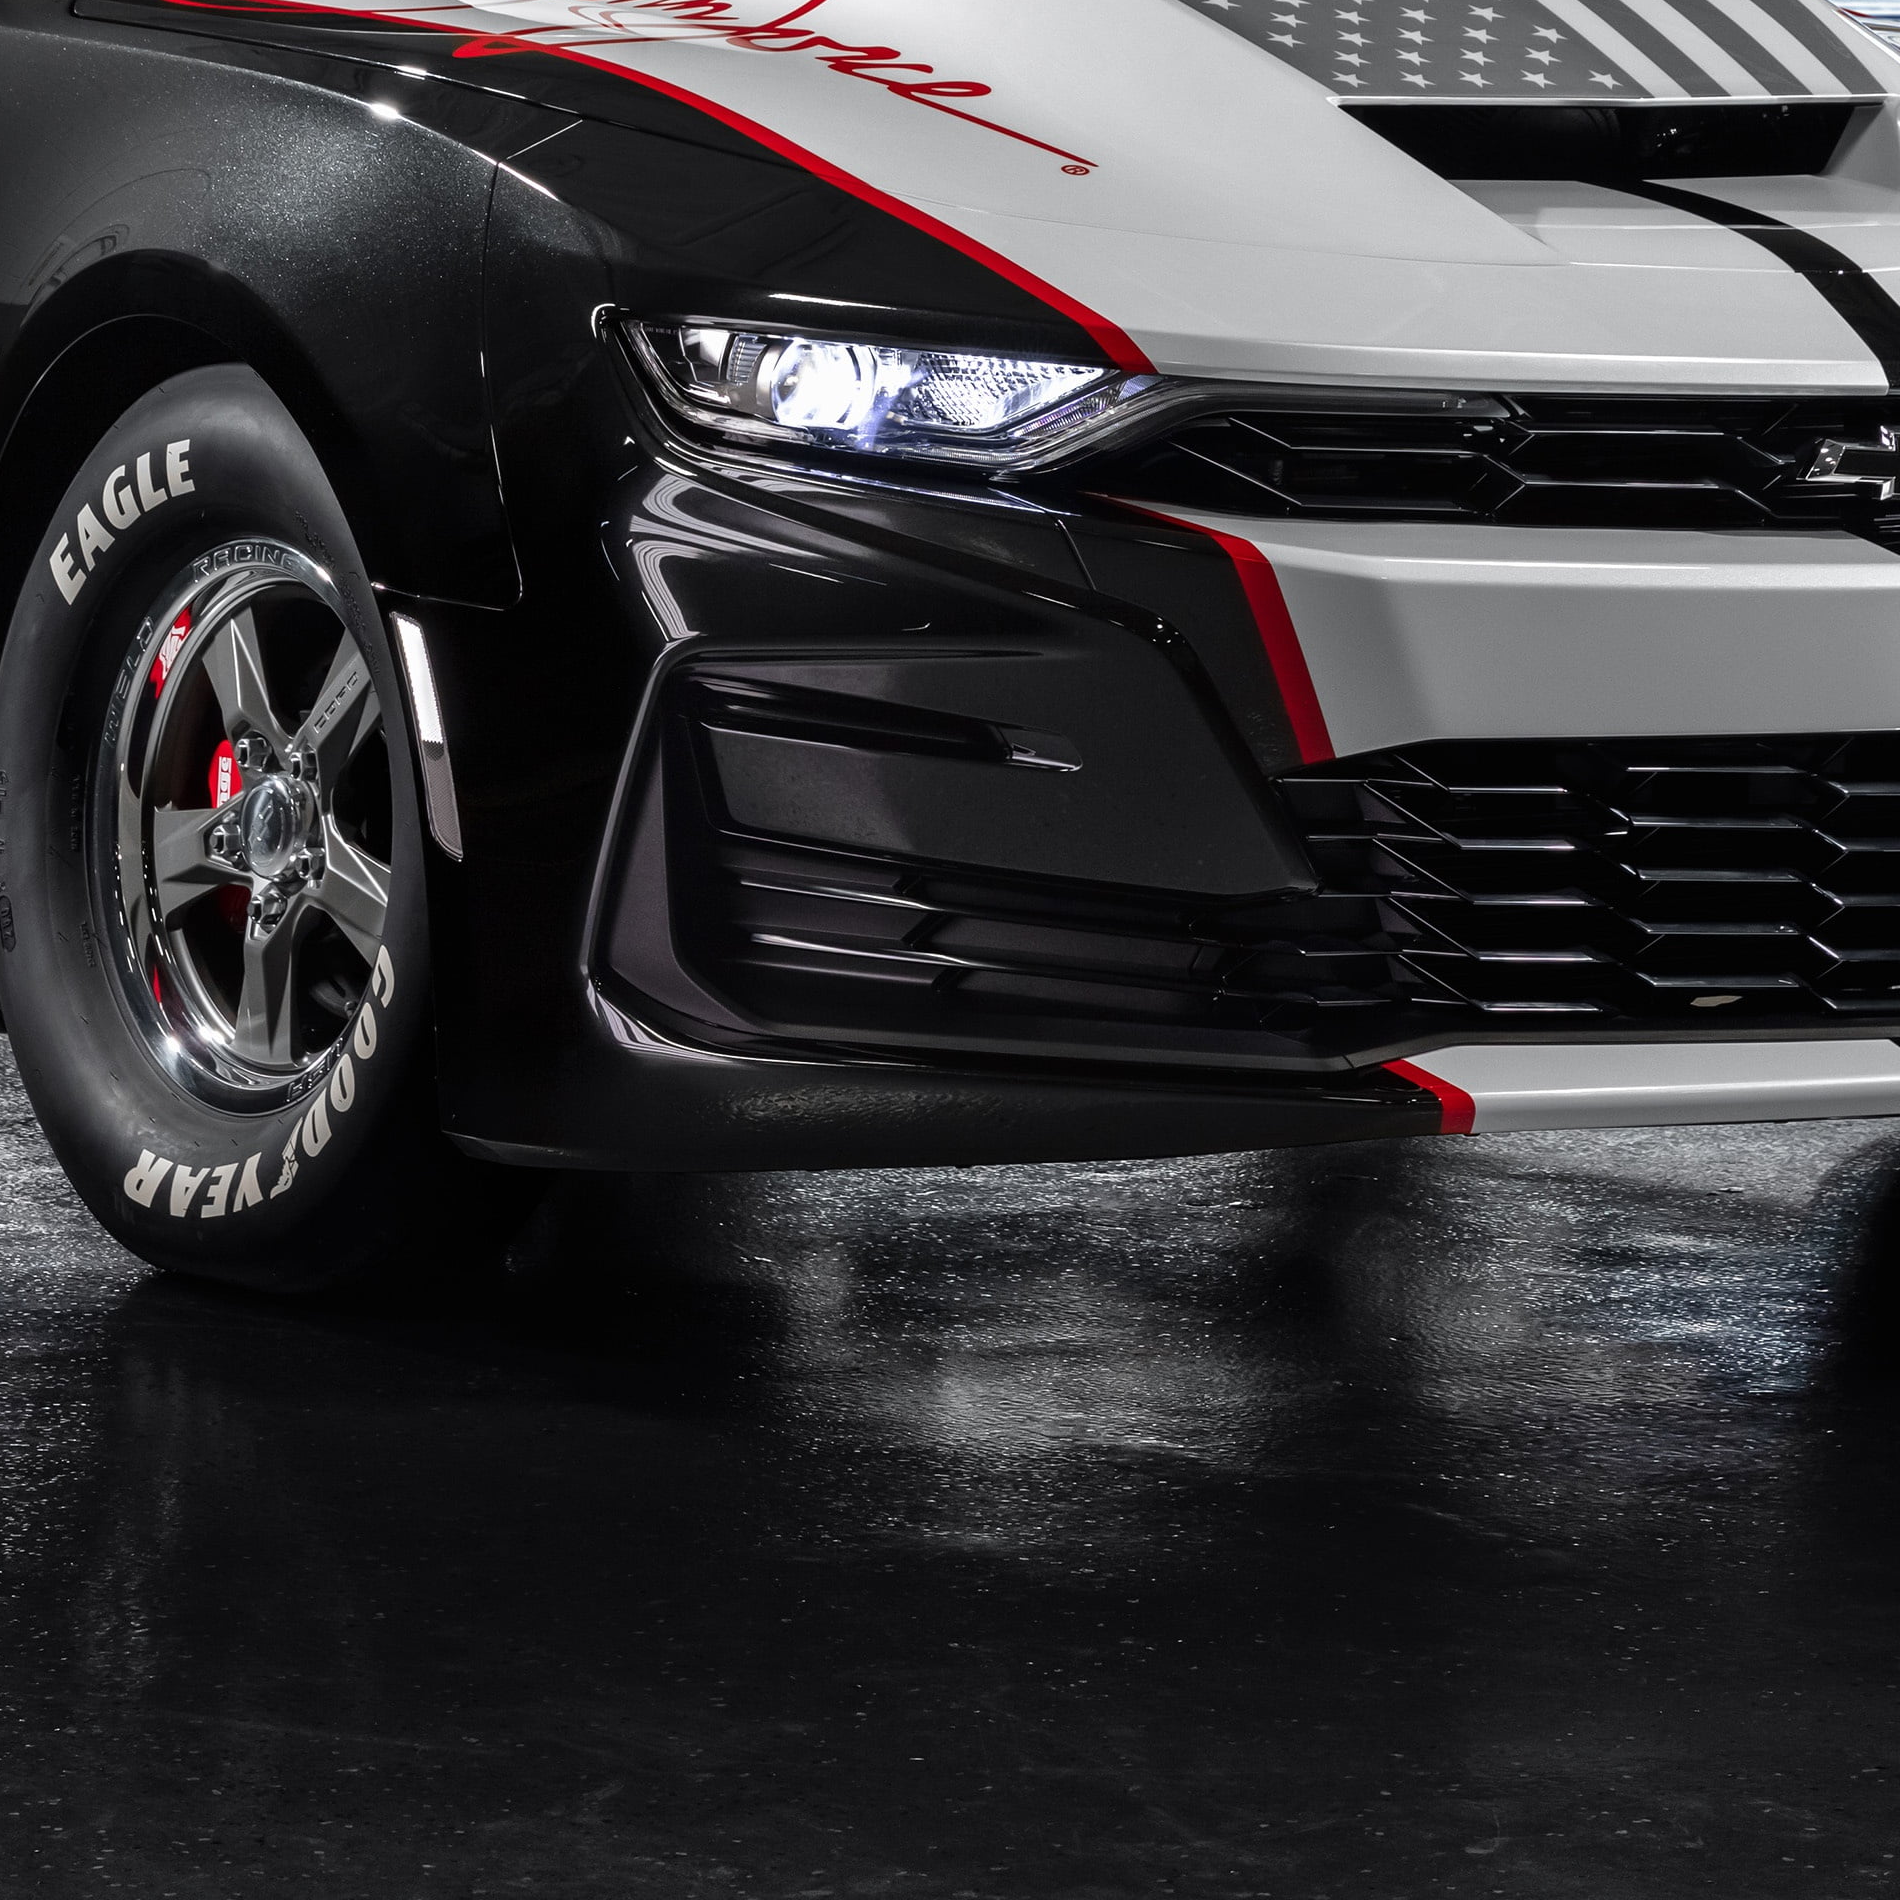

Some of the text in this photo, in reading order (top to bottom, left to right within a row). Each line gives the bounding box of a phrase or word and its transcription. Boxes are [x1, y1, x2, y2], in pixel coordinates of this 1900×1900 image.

[49, 438, 196, 606] EAGLE
[103, 614, 155, 749] WELD
[312, 671, 358, 734] COPO
